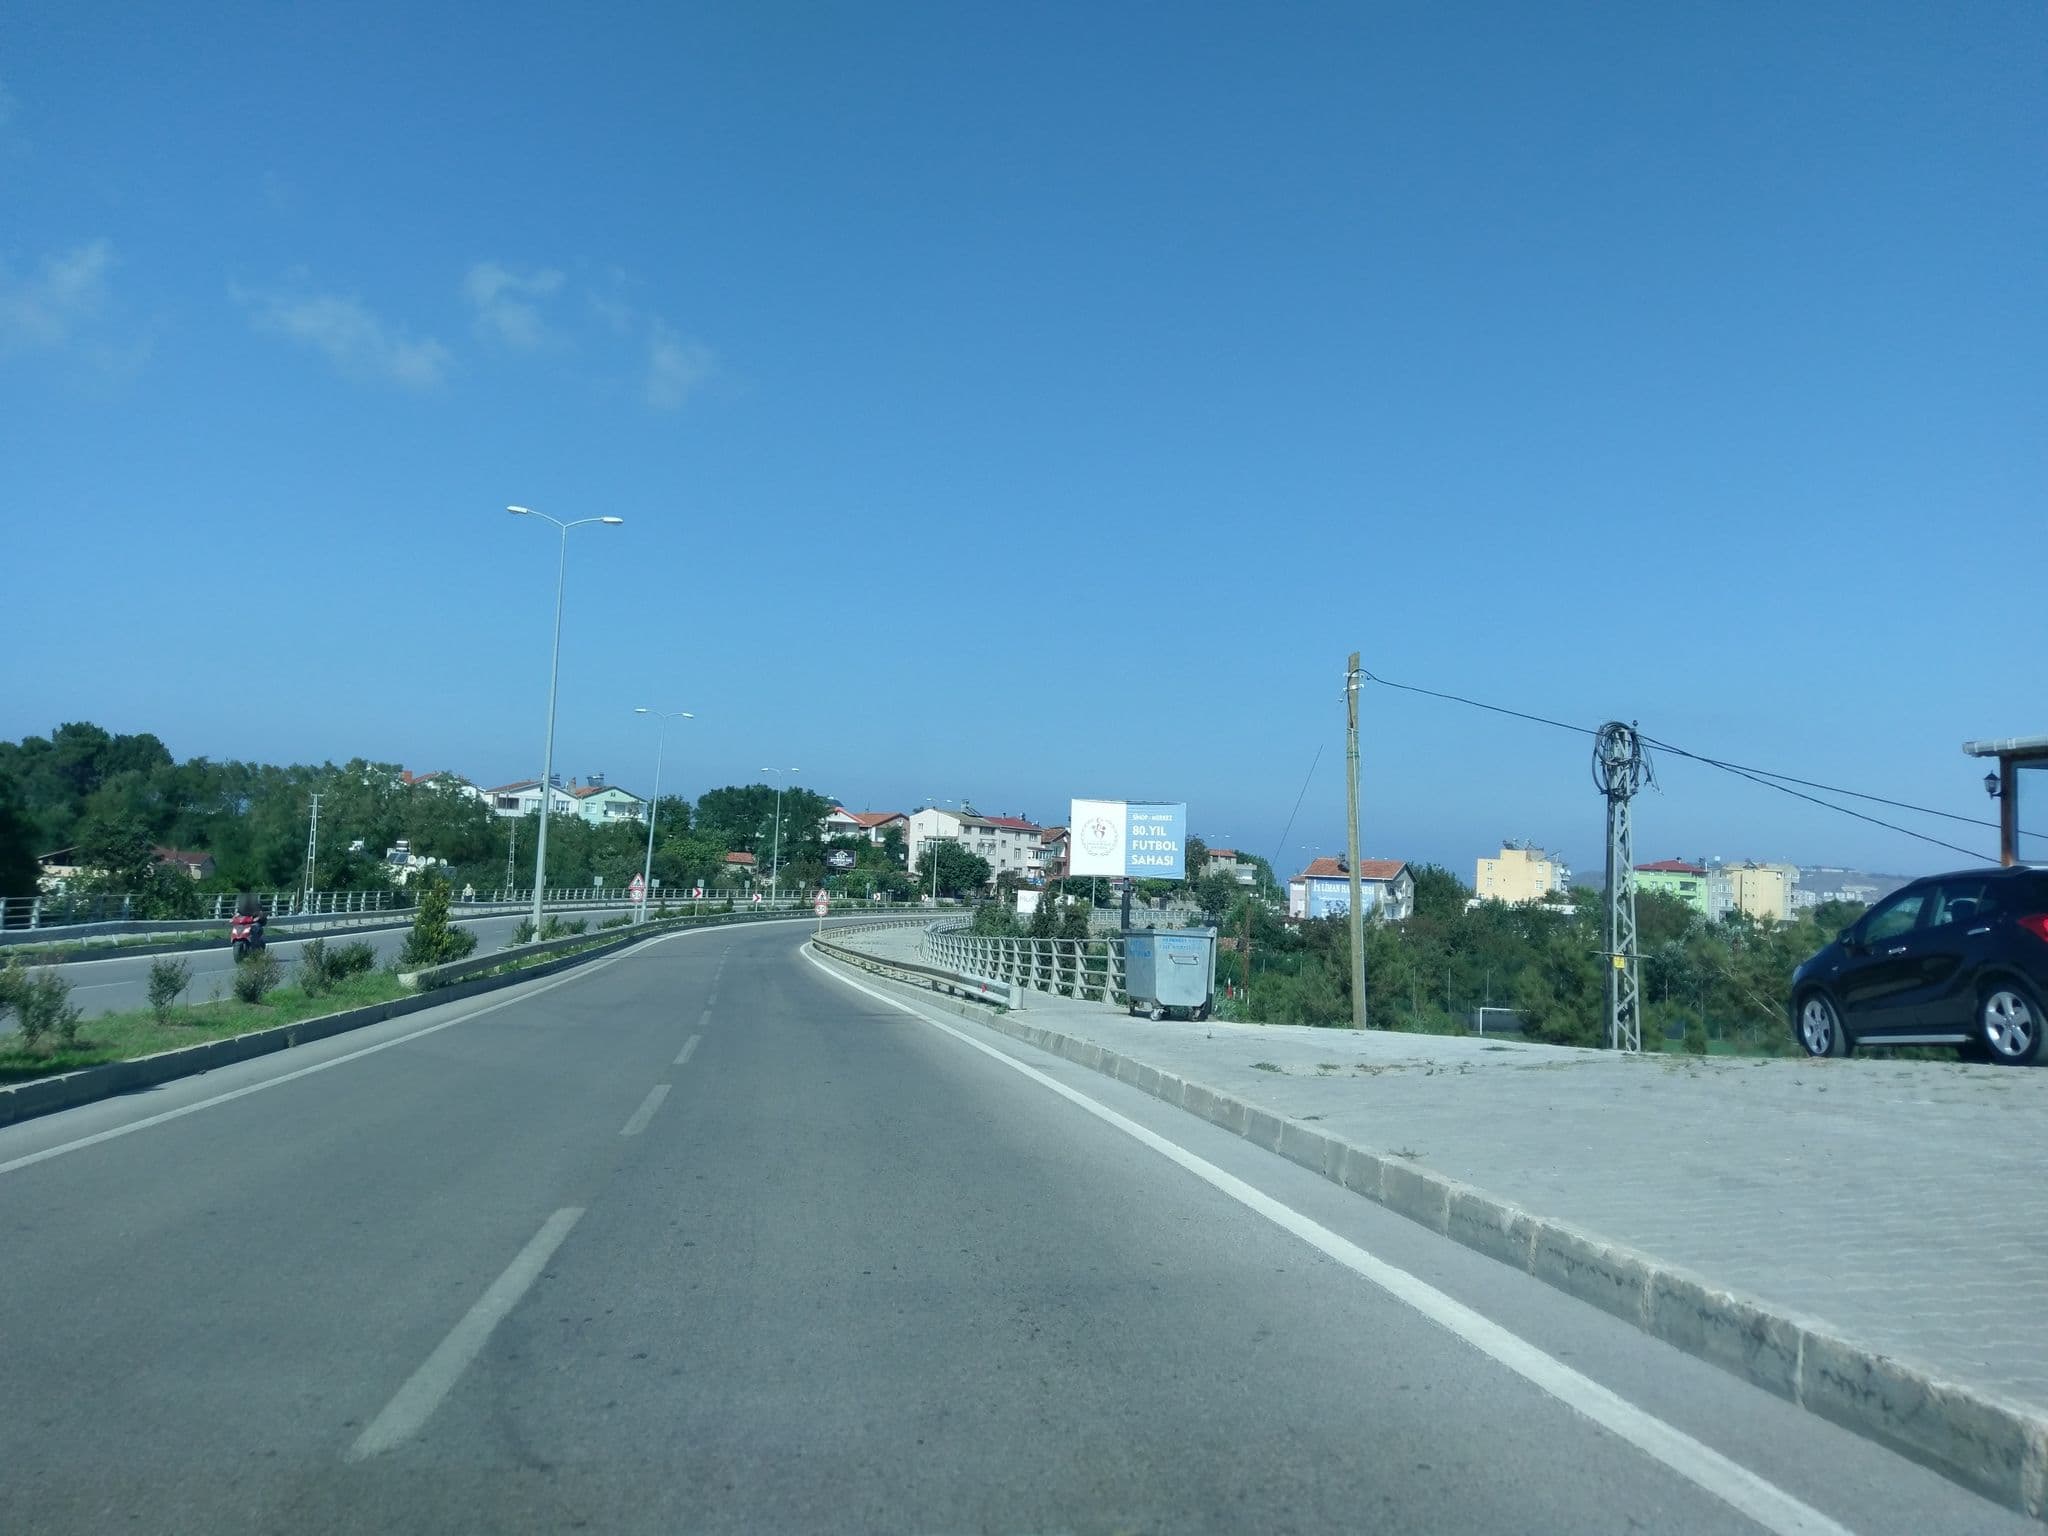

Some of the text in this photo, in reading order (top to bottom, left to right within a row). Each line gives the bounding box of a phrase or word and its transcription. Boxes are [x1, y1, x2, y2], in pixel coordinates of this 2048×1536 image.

[1132, 825, 1167, 836] 80.YIL
[1132, 840, 1178, 852] FUTBOL
[1131, 854, 1174, 866] SAHASI
